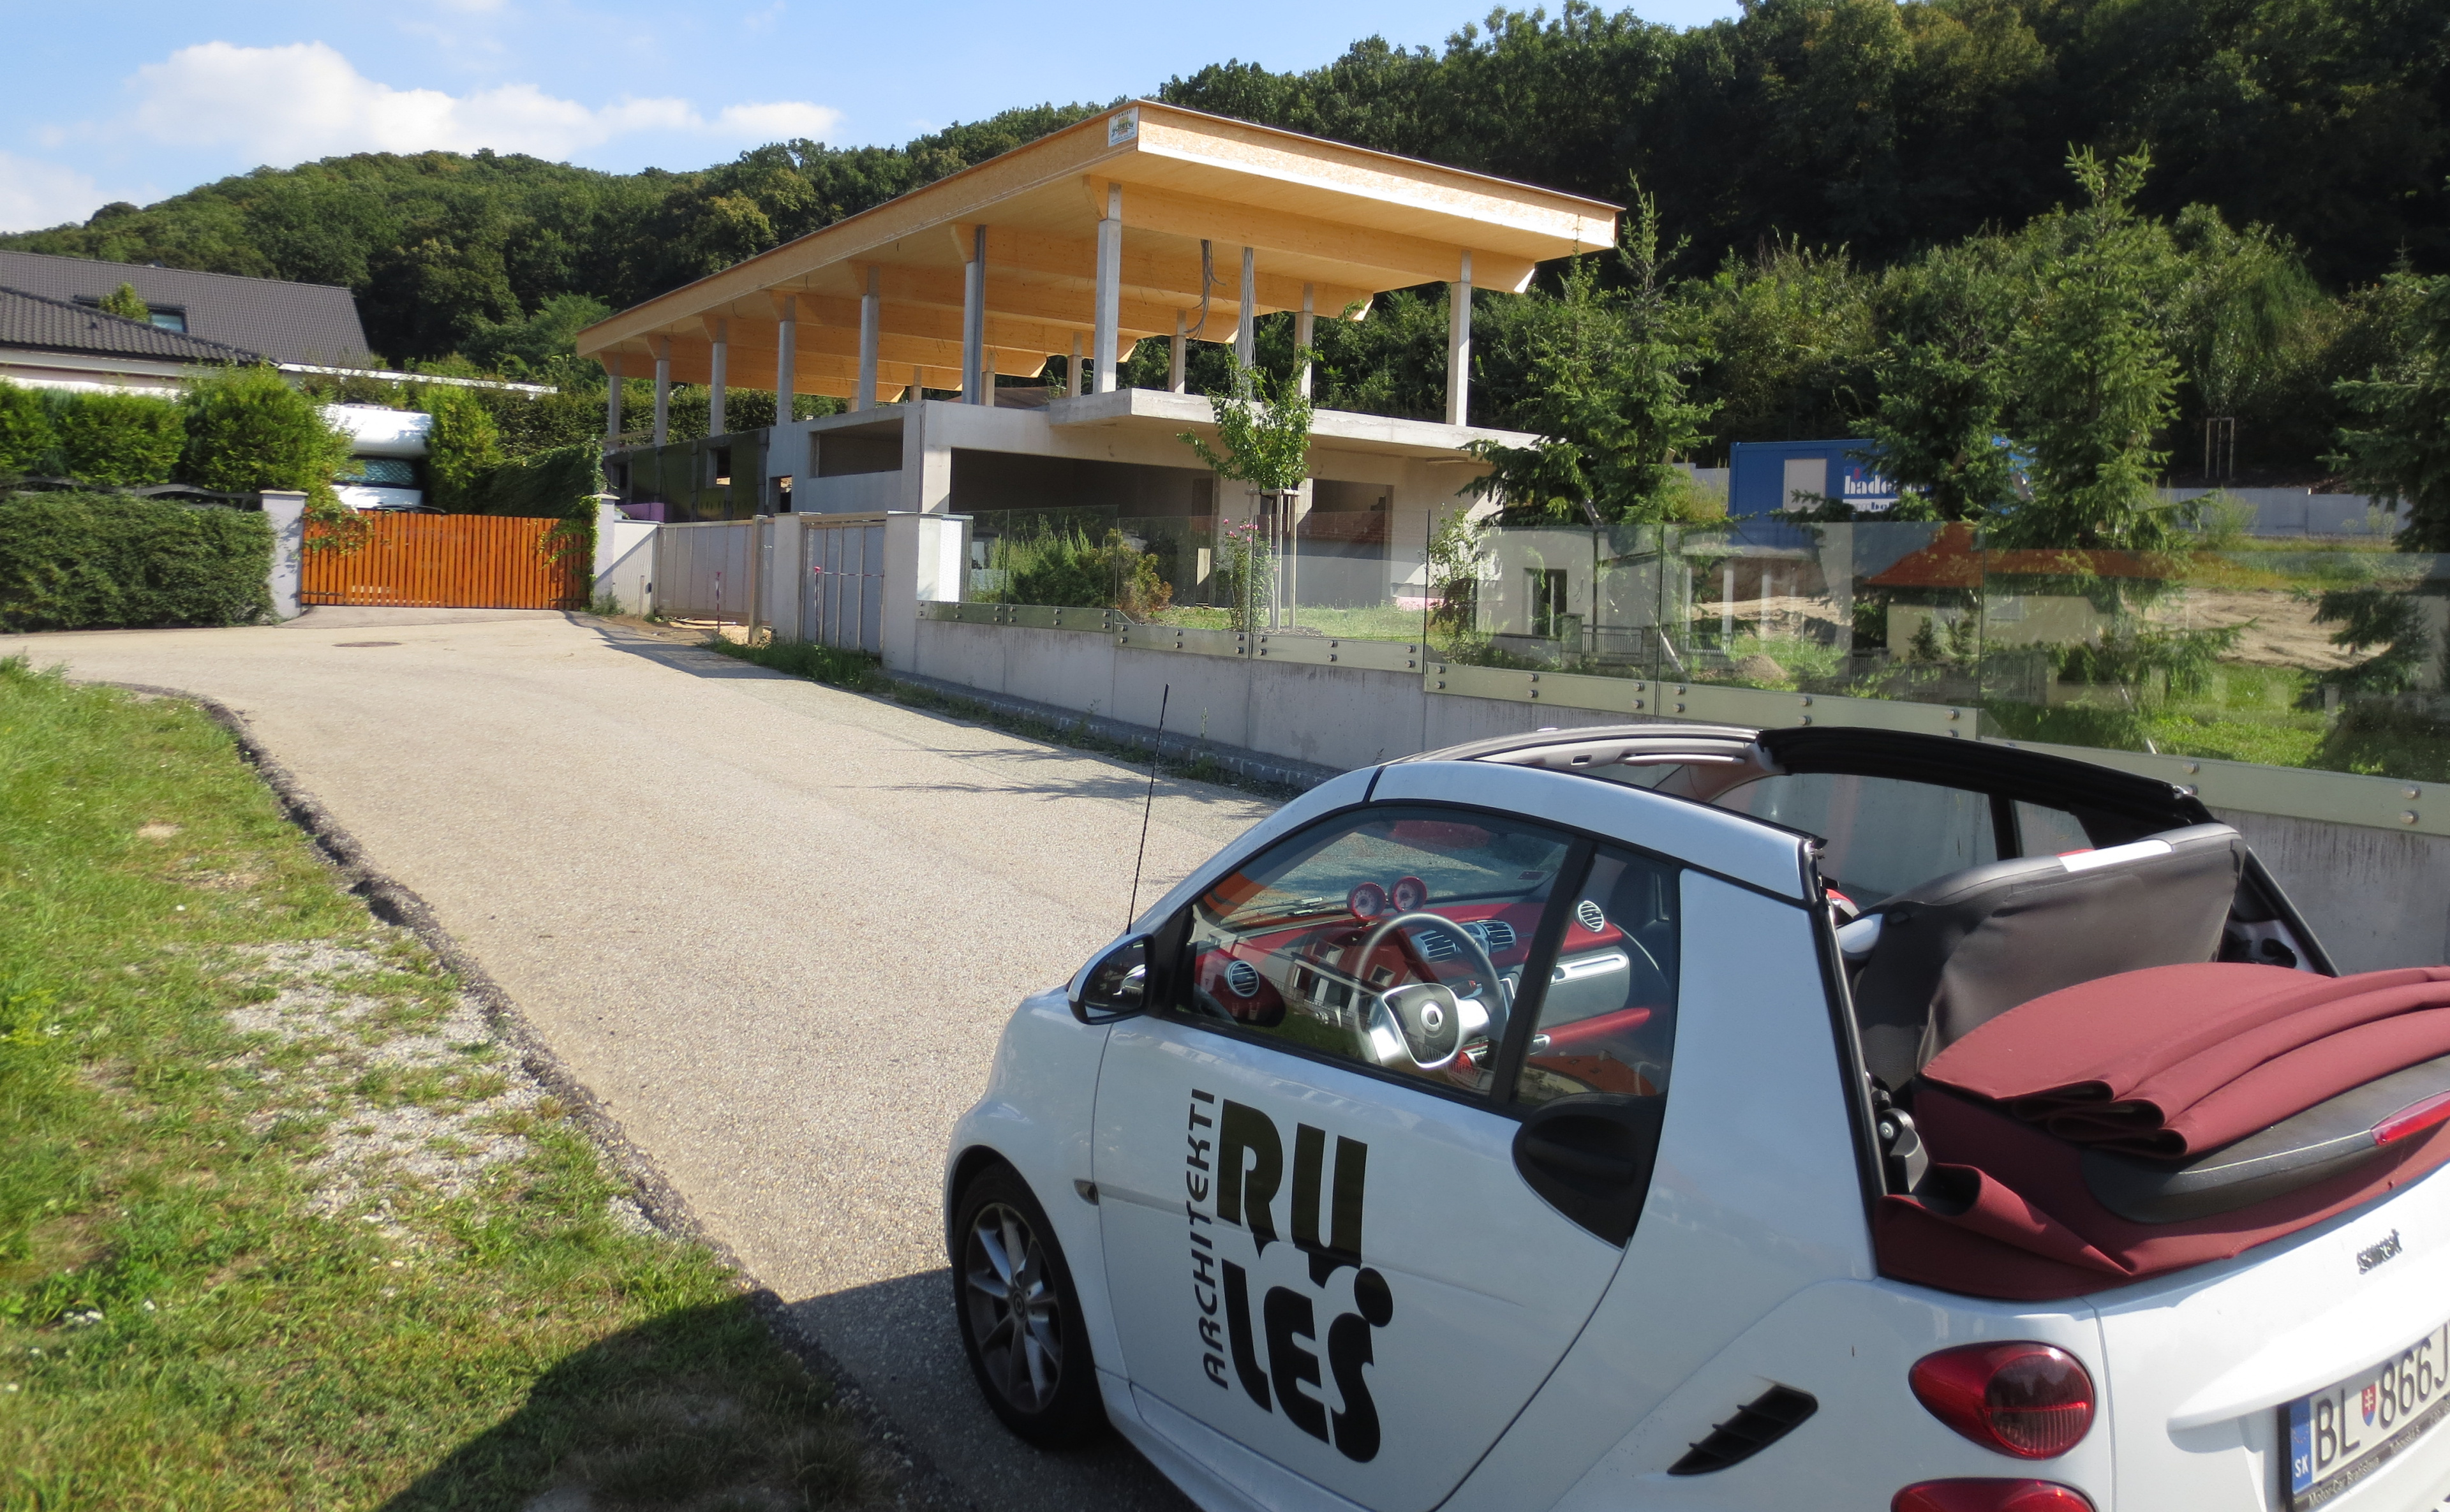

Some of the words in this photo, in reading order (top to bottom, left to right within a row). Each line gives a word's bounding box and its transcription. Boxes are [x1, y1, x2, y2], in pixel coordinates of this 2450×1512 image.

[1186, 1088, 1229, 1391] ARCHITEKTI
[2294, 1454, 2309, 1478] SK
[2315, 1387, 2361, 1472] BL
[2380, 1321, 2450, 1430] 866J
